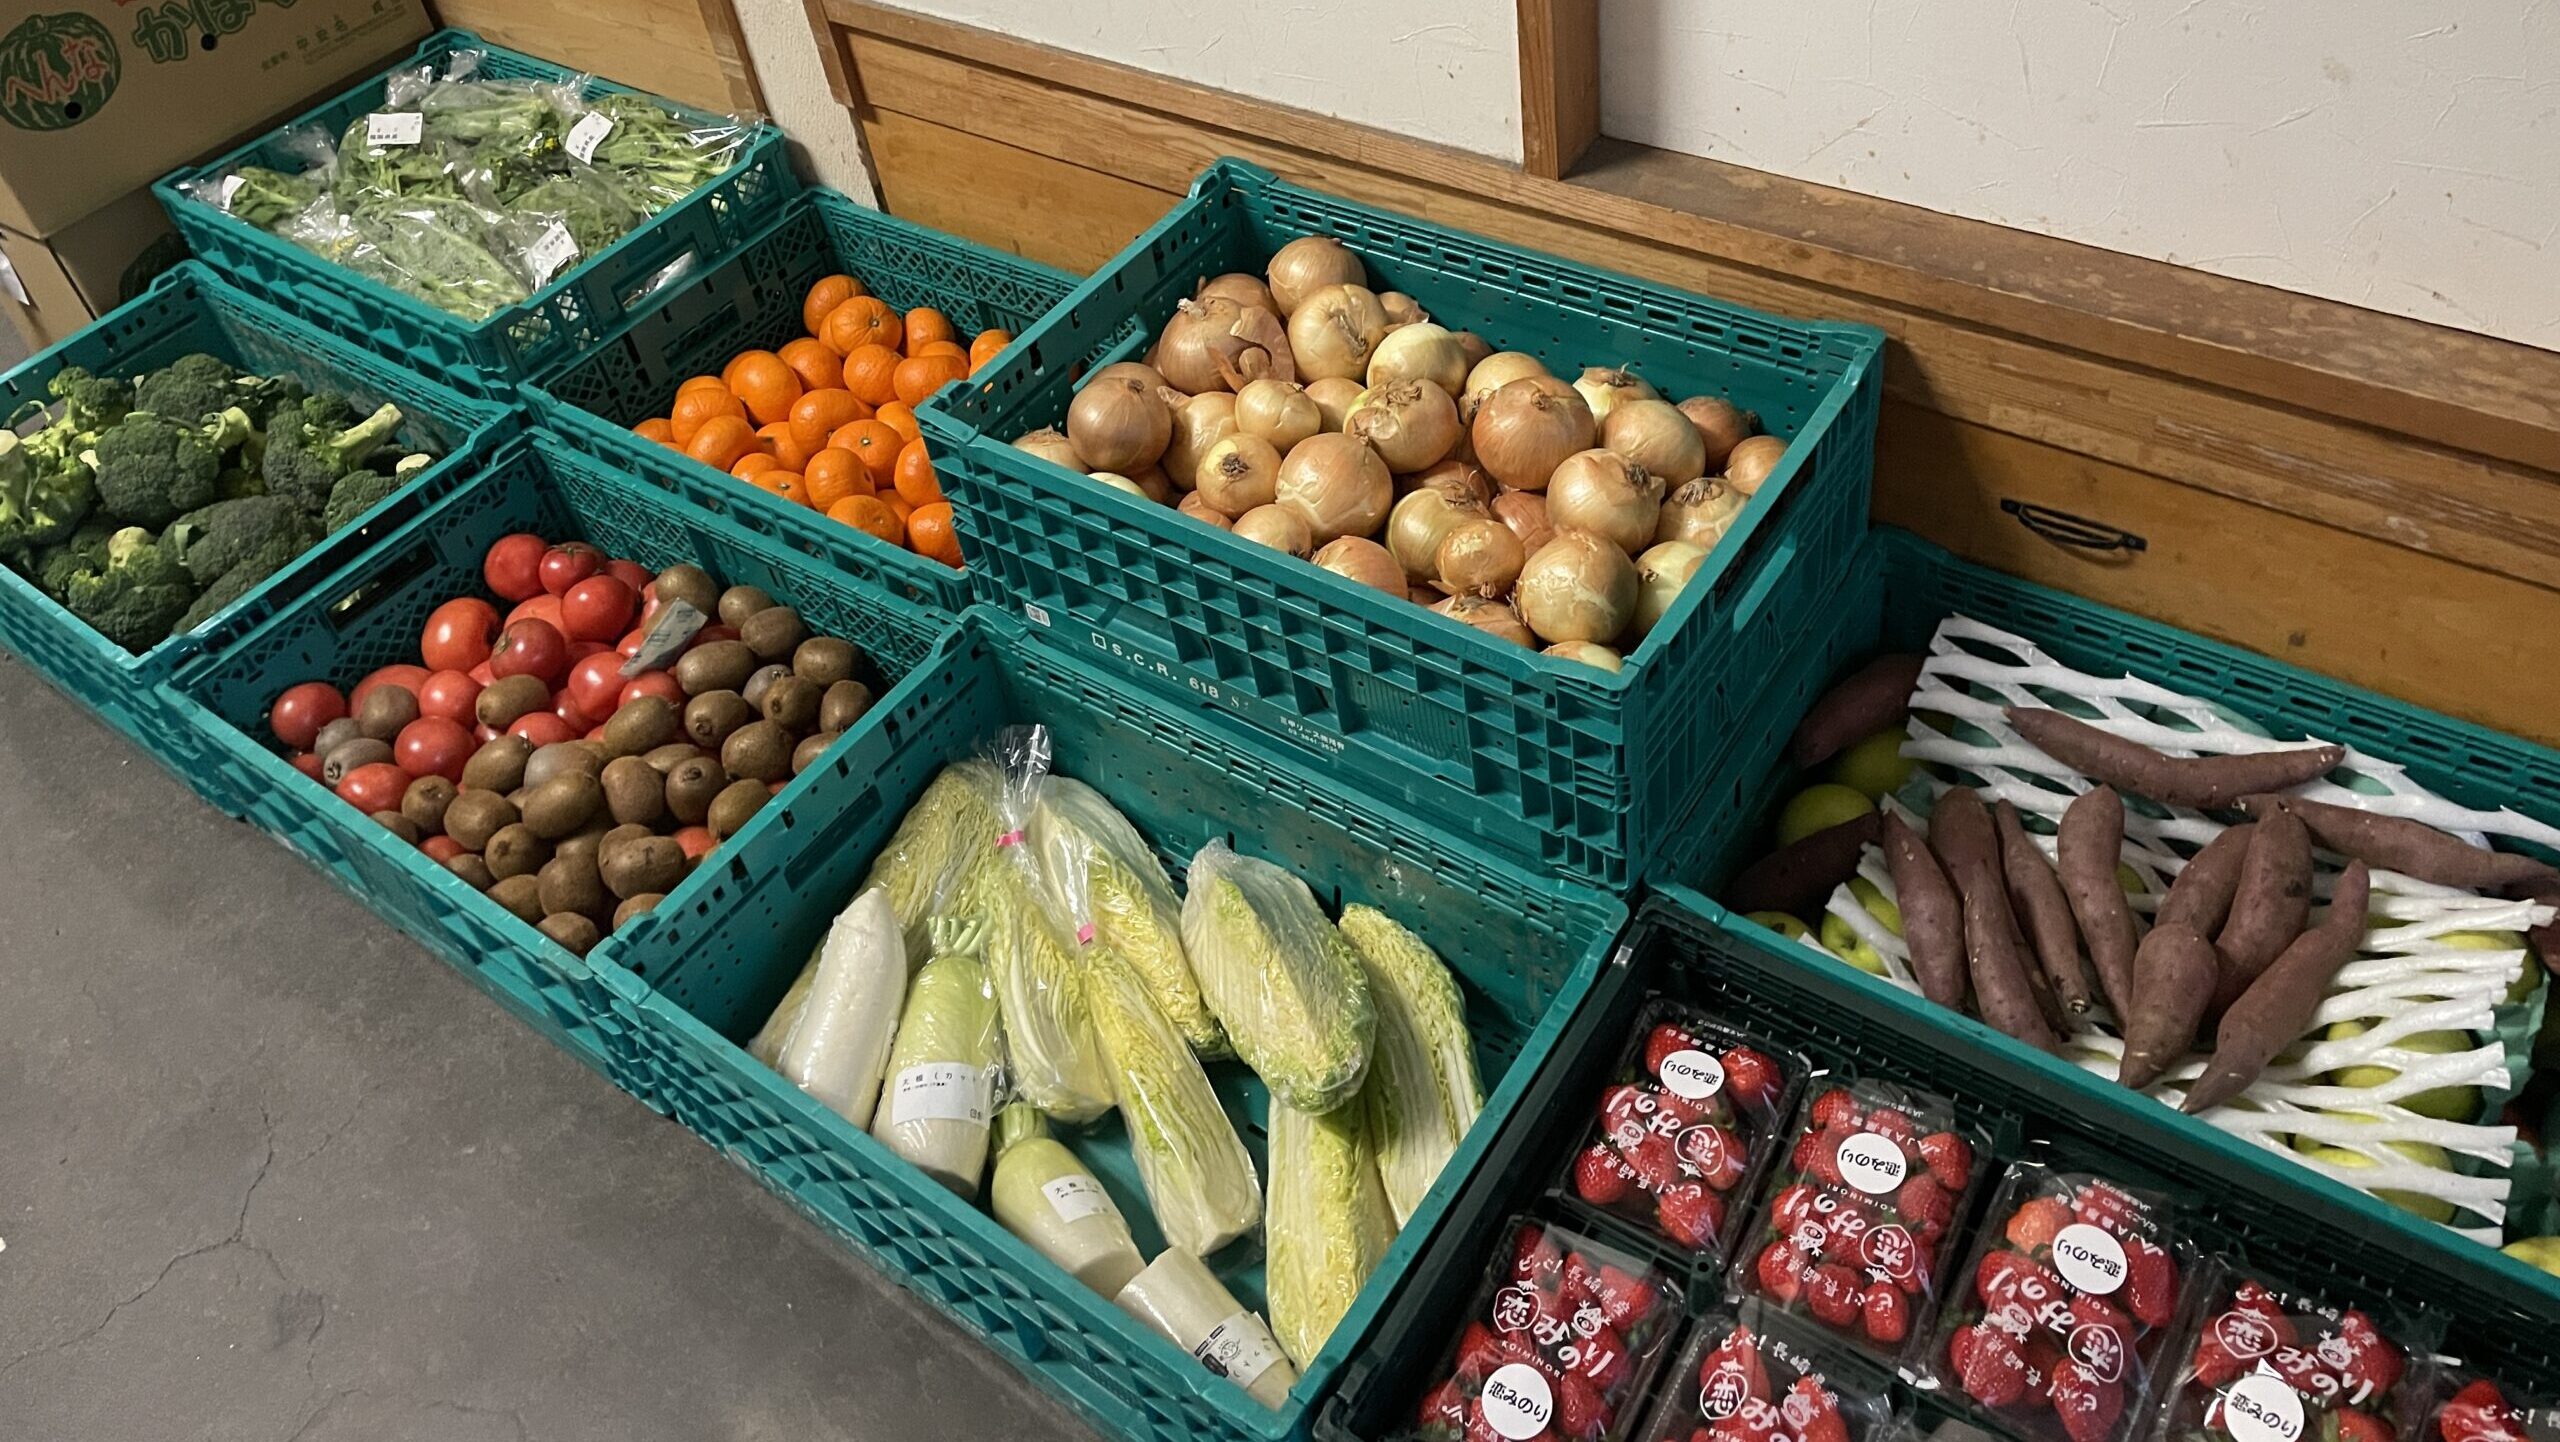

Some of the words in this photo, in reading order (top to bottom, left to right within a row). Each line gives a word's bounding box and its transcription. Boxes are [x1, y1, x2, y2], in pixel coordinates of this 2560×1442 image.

[6, 37, 108, 105] へんな
[1188, 676, 1219, 699] 618
[1664, 1060, 1719, 1085] 恋みのり
[1606, 1089, 1720, 1166] 恋みのり
[1840, 1149, 1901, 1177] 恋みのり
[1826, 1183, 1897, 1214] KOIMINORI
[1783, 1188, 1910, 1267] 恋みのり
[2057, 1239, 2122, 1278] 恋みのり
[2037, 1265, 2110, 1316] KOIMINORI
[1498, 1294, 1615, 1378] 恋みのり
[1987, 1267, 2120, 1372] 恋みのり
[2224, 1319, 2375, 1406] 恋みのり
[1487, 1381, 1548, 1423] 恋みのり
[2230, 1392, 2298, 1438] 恋みのり
